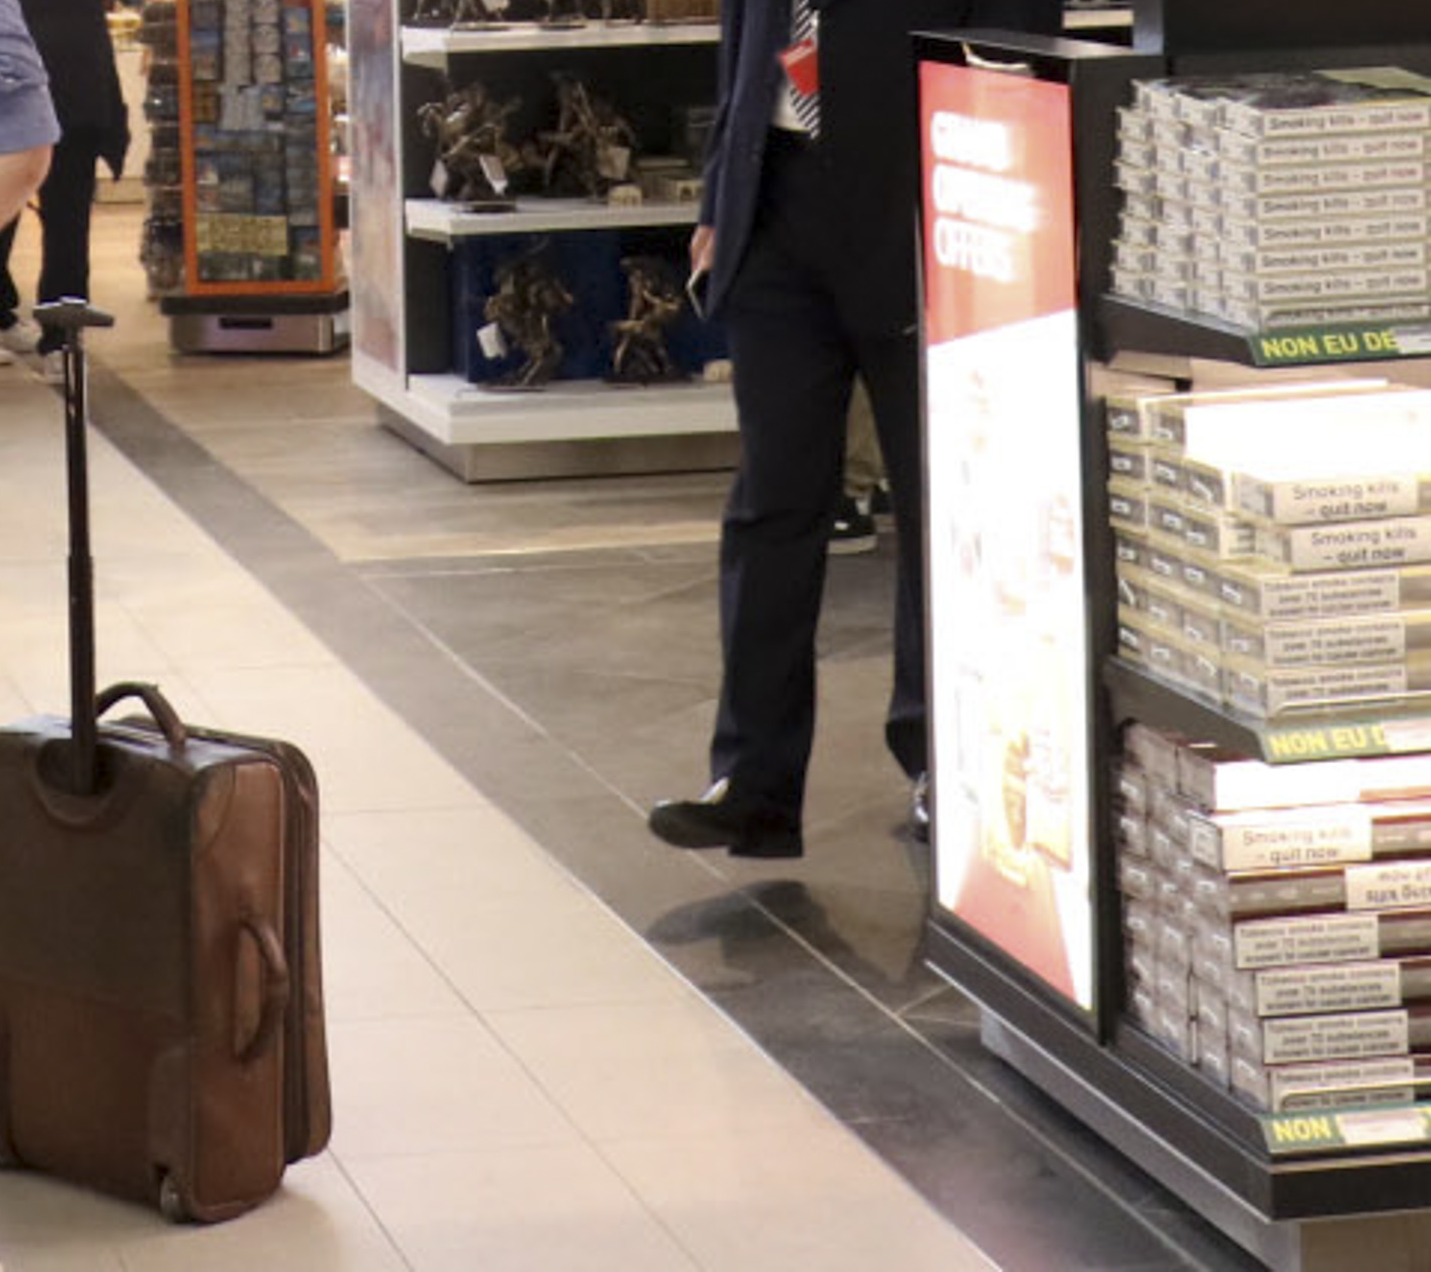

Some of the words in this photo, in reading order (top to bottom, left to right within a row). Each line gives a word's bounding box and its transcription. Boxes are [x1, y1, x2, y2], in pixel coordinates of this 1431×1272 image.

[1260, 338, 1318, 358] NON
[1322, 333, 1359, 353] EU
[1267, 733, 1329, 756] NON
[1331, 727, 1368, 750] EU
[1272, 1117, 1332, 1142] NON
